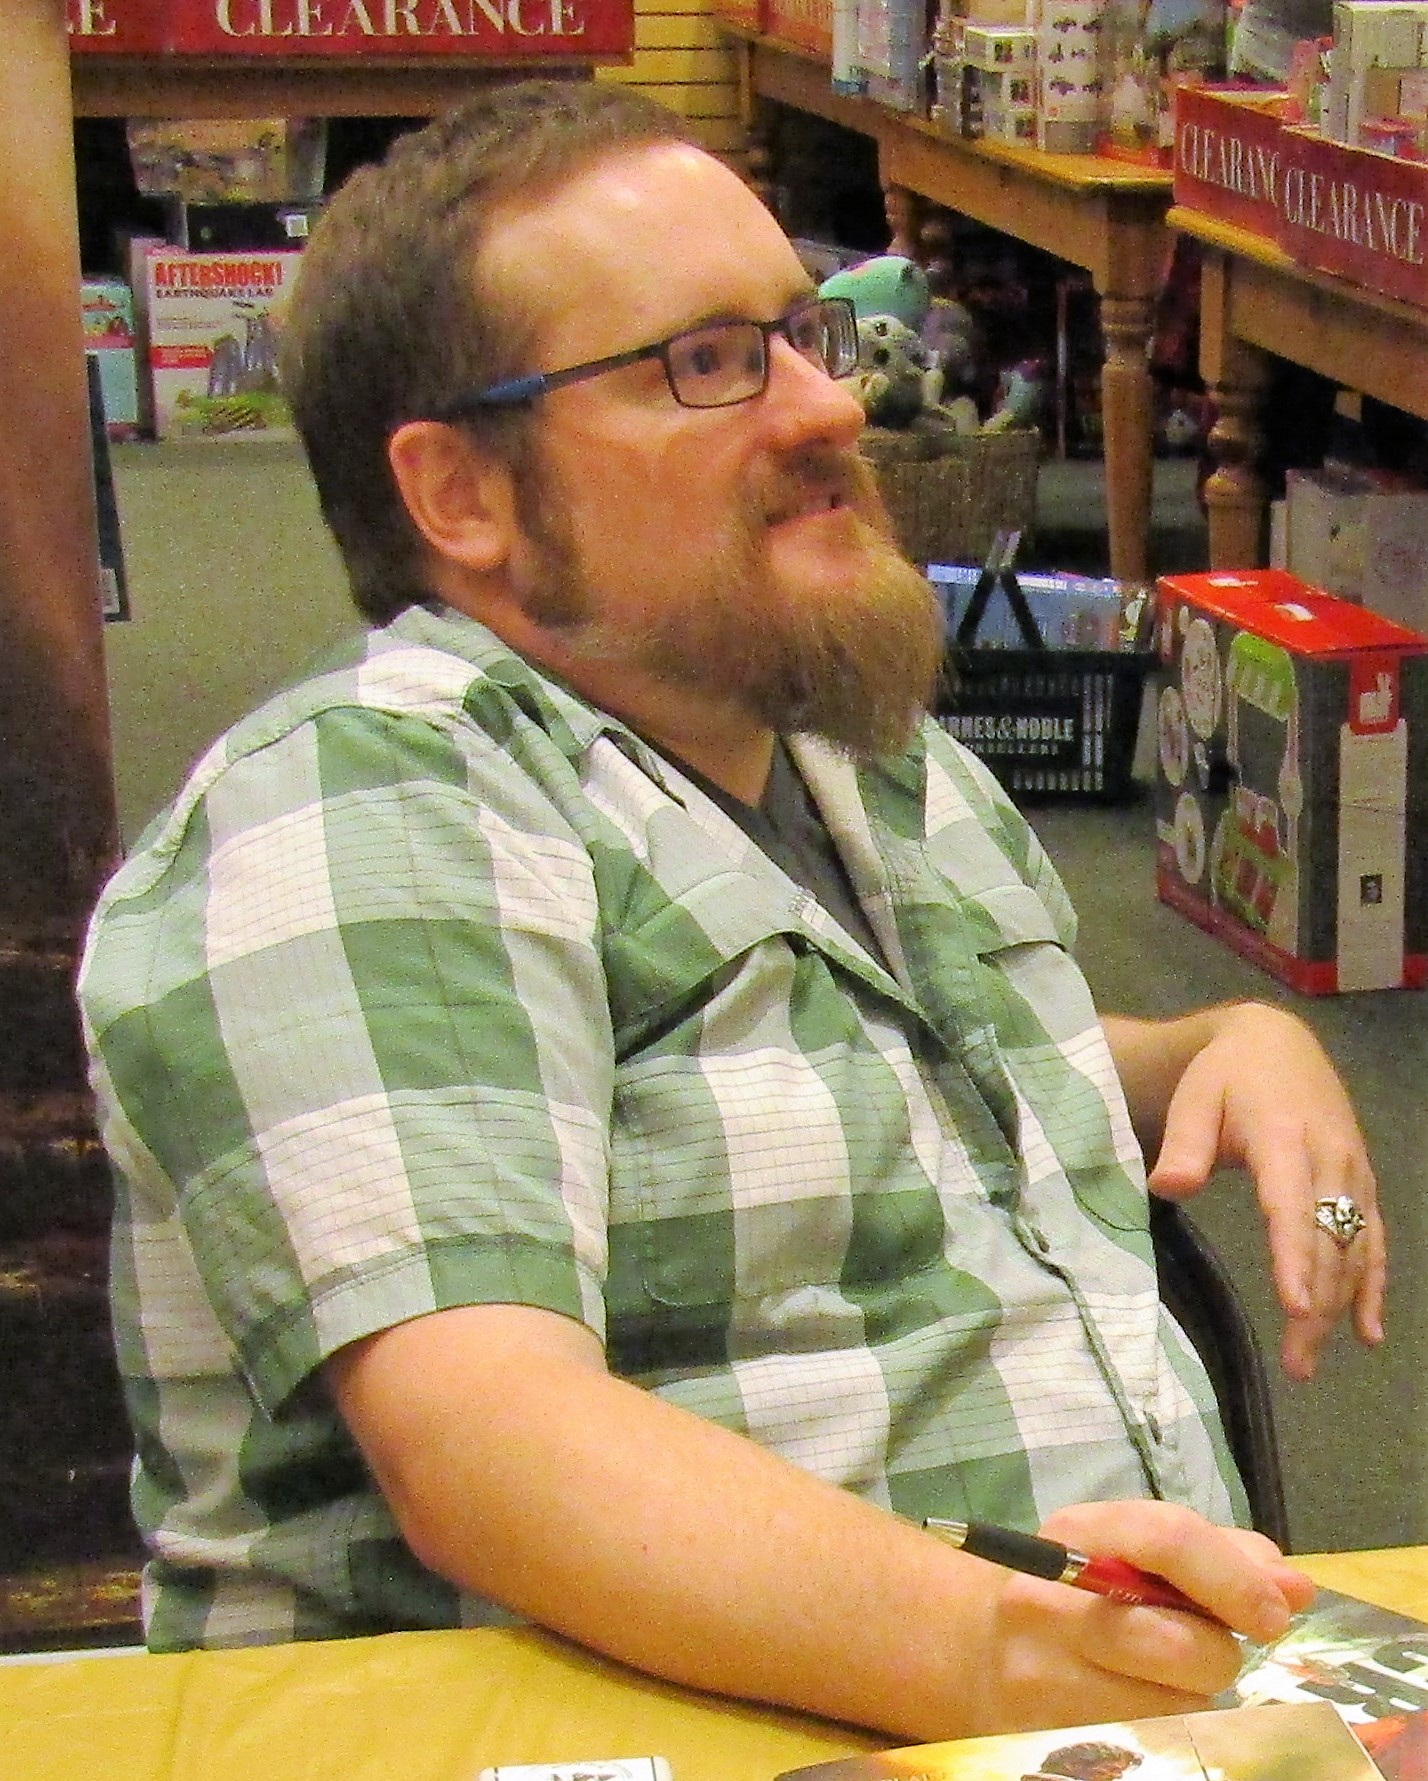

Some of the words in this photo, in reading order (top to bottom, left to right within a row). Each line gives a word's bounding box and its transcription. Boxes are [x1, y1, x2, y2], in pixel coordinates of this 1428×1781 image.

[215, 0, 585, 37] CLEARANCE
[1285, 166, 1424, 265] CLEARANCE
[155, 261, 284, 287] AFTERSHOCK!
